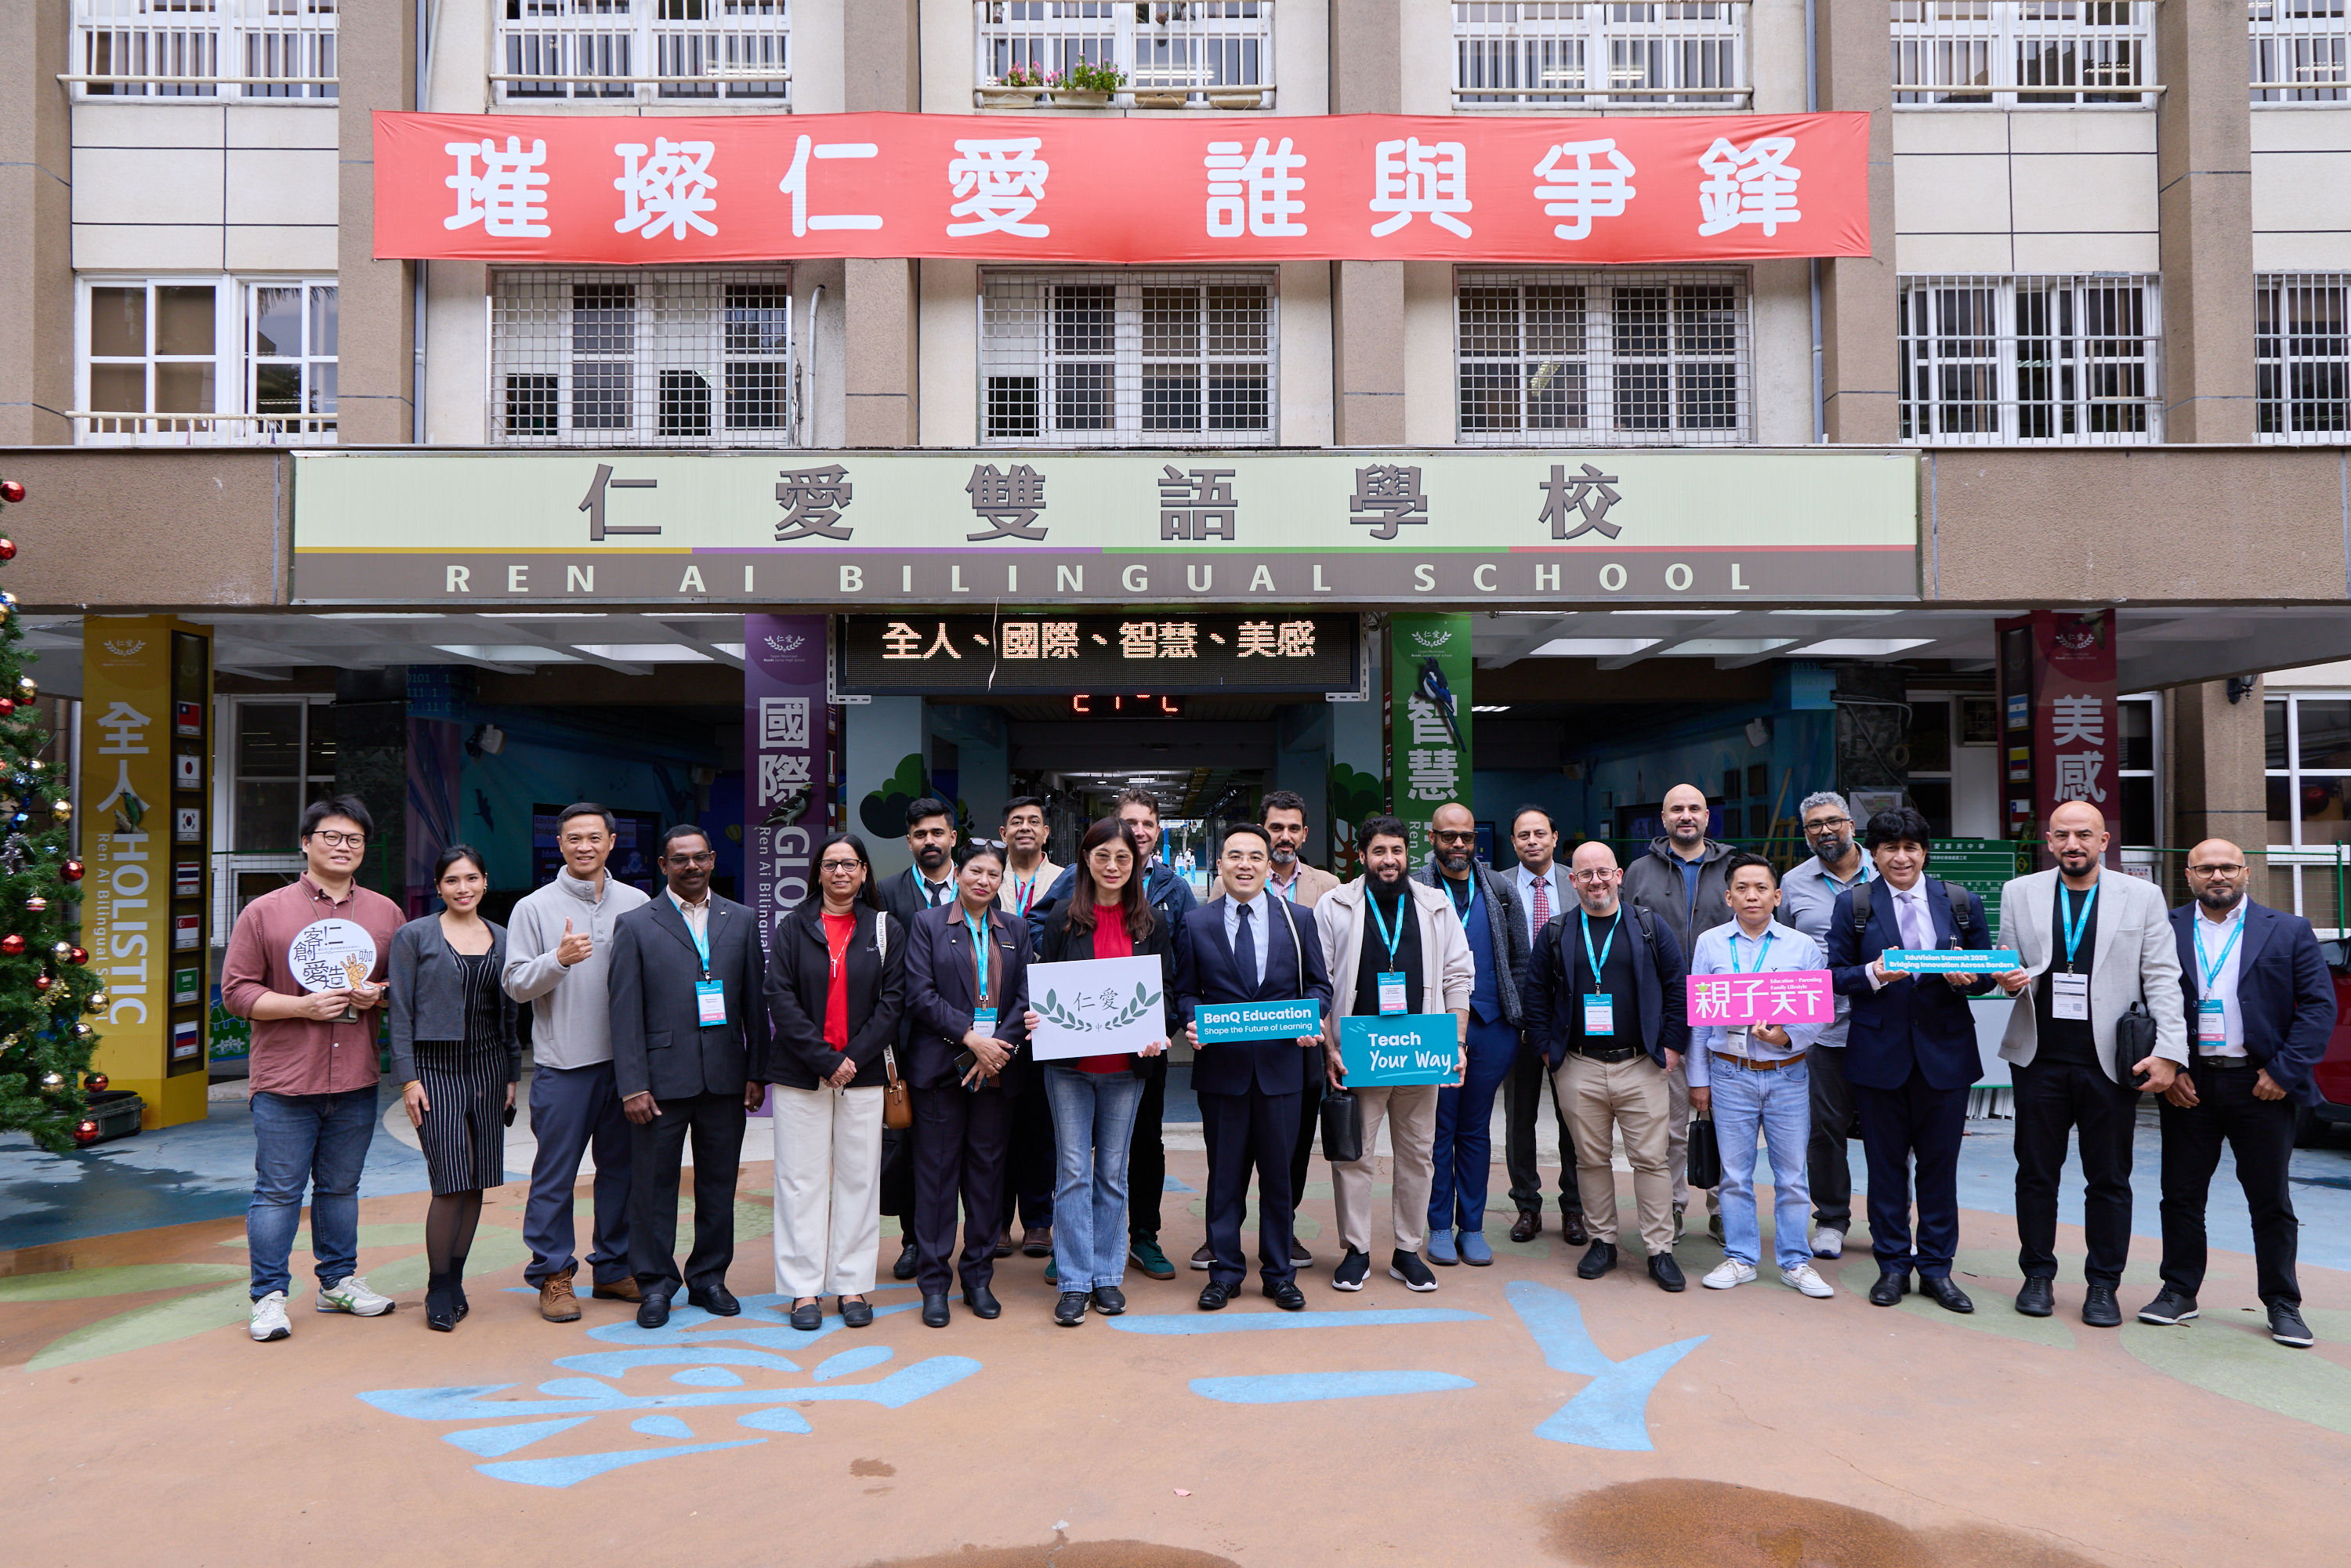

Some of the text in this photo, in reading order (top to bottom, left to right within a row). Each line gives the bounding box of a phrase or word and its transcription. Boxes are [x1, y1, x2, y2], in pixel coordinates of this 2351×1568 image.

[443, 133, 1802, 241] 璀璨仁愛 誰與爭鋒
[578, 462, 1623, 542] 仁愛雙語學校
[445, 562, 1751, 593] REN AI BILINGUAL SCHOOL
[882, 620, 1317, 660] 全人、國際、智慧、美感
[97, 701, 152, 813] 全人
[758, 697, 811, 806] 國際
[1407, 695, 1459, 801] 智慧
[2052, 693, 2107, 804] 美感
[97, 833, 110, 862] Ren
[759, 827, 771, 855] Ren
[1409, 821, 1421, 849] Ren
[96, 867, 110, 884] Ai
[759, 861, 771, 876] Ai
[93, 889, 110, 961] Bilingual
[110, 833, 149, 1025] HOLISTIC
[1889, 961, 1920, 969] Bridging
[1073, 987, 1119, 1012] 仁愛
[1695, 980, 1824, 1019] 親子天下
[1204, 1007, 1312, 1024] BenQ Education
[1204, 1027, 1229, 1036] Shape
[1244, 1023, 1269, 1033] Future
[1270, 1023, 1278, 1031] of
[1280, 1022, 1313, 1031] Learning
[1367, 1031, 1422, 1047] Teach
[1369, 1049, 1451, 1076] Your Way
